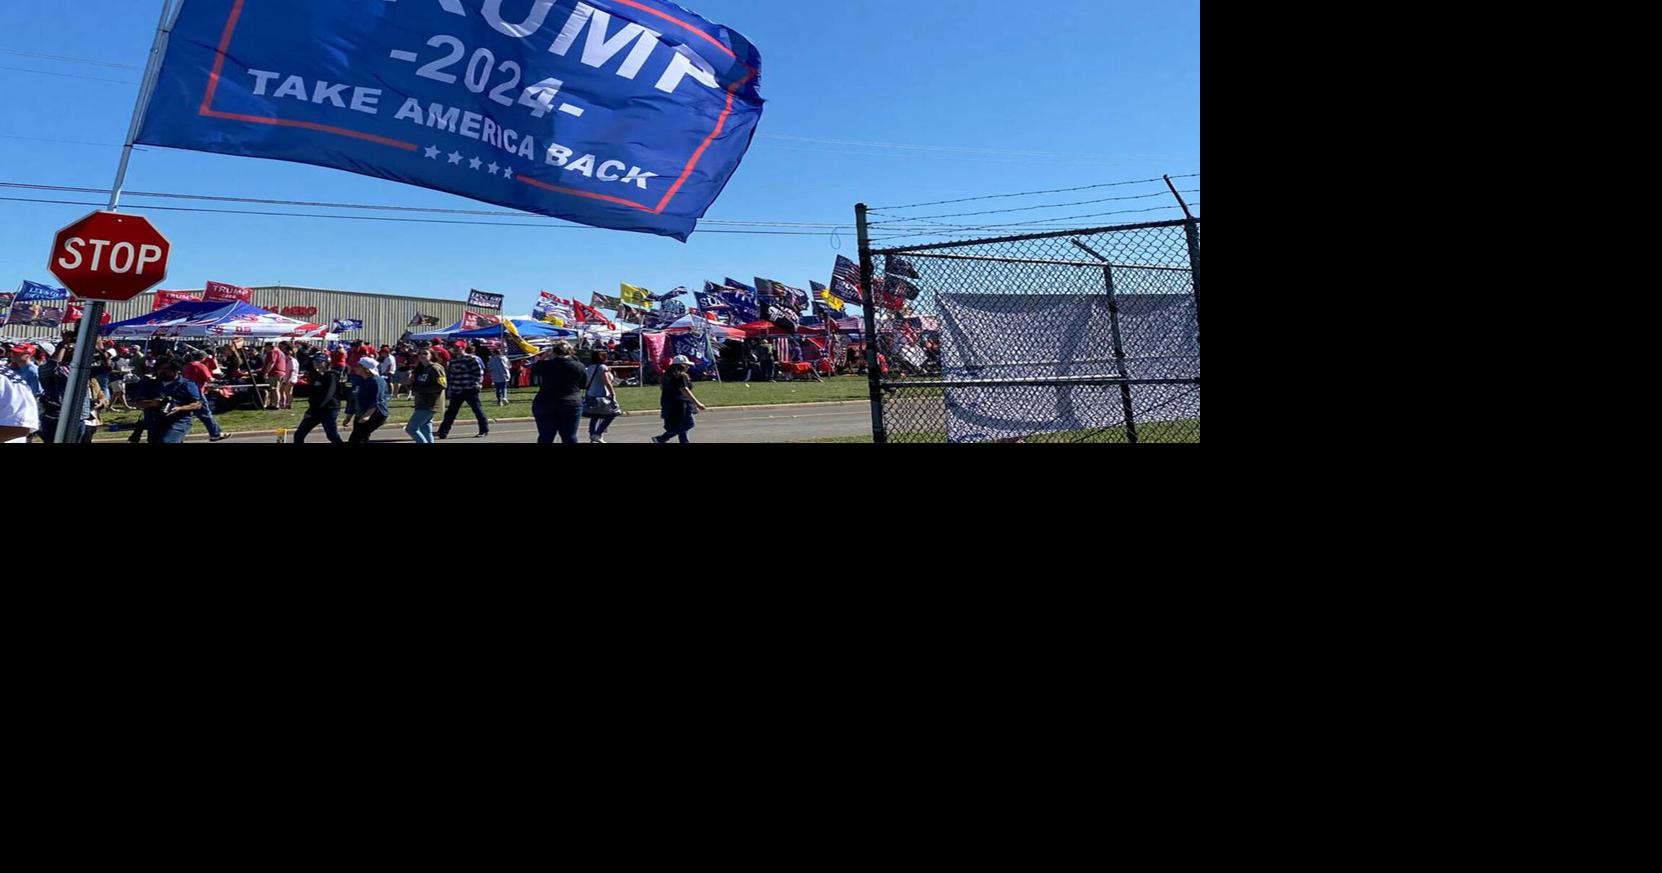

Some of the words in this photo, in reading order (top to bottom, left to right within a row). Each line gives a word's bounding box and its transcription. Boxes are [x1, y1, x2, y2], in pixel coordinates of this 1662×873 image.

[390, 34, 584, 118] -2024-
[247, 68, 382, 114] TAKE
[394, 97, 535, 161] AMERICA
[544, 142, 659, 190] BACK
[58, 237, 162, 275] STOP
[213, 284, 249, 297] TRUMP
